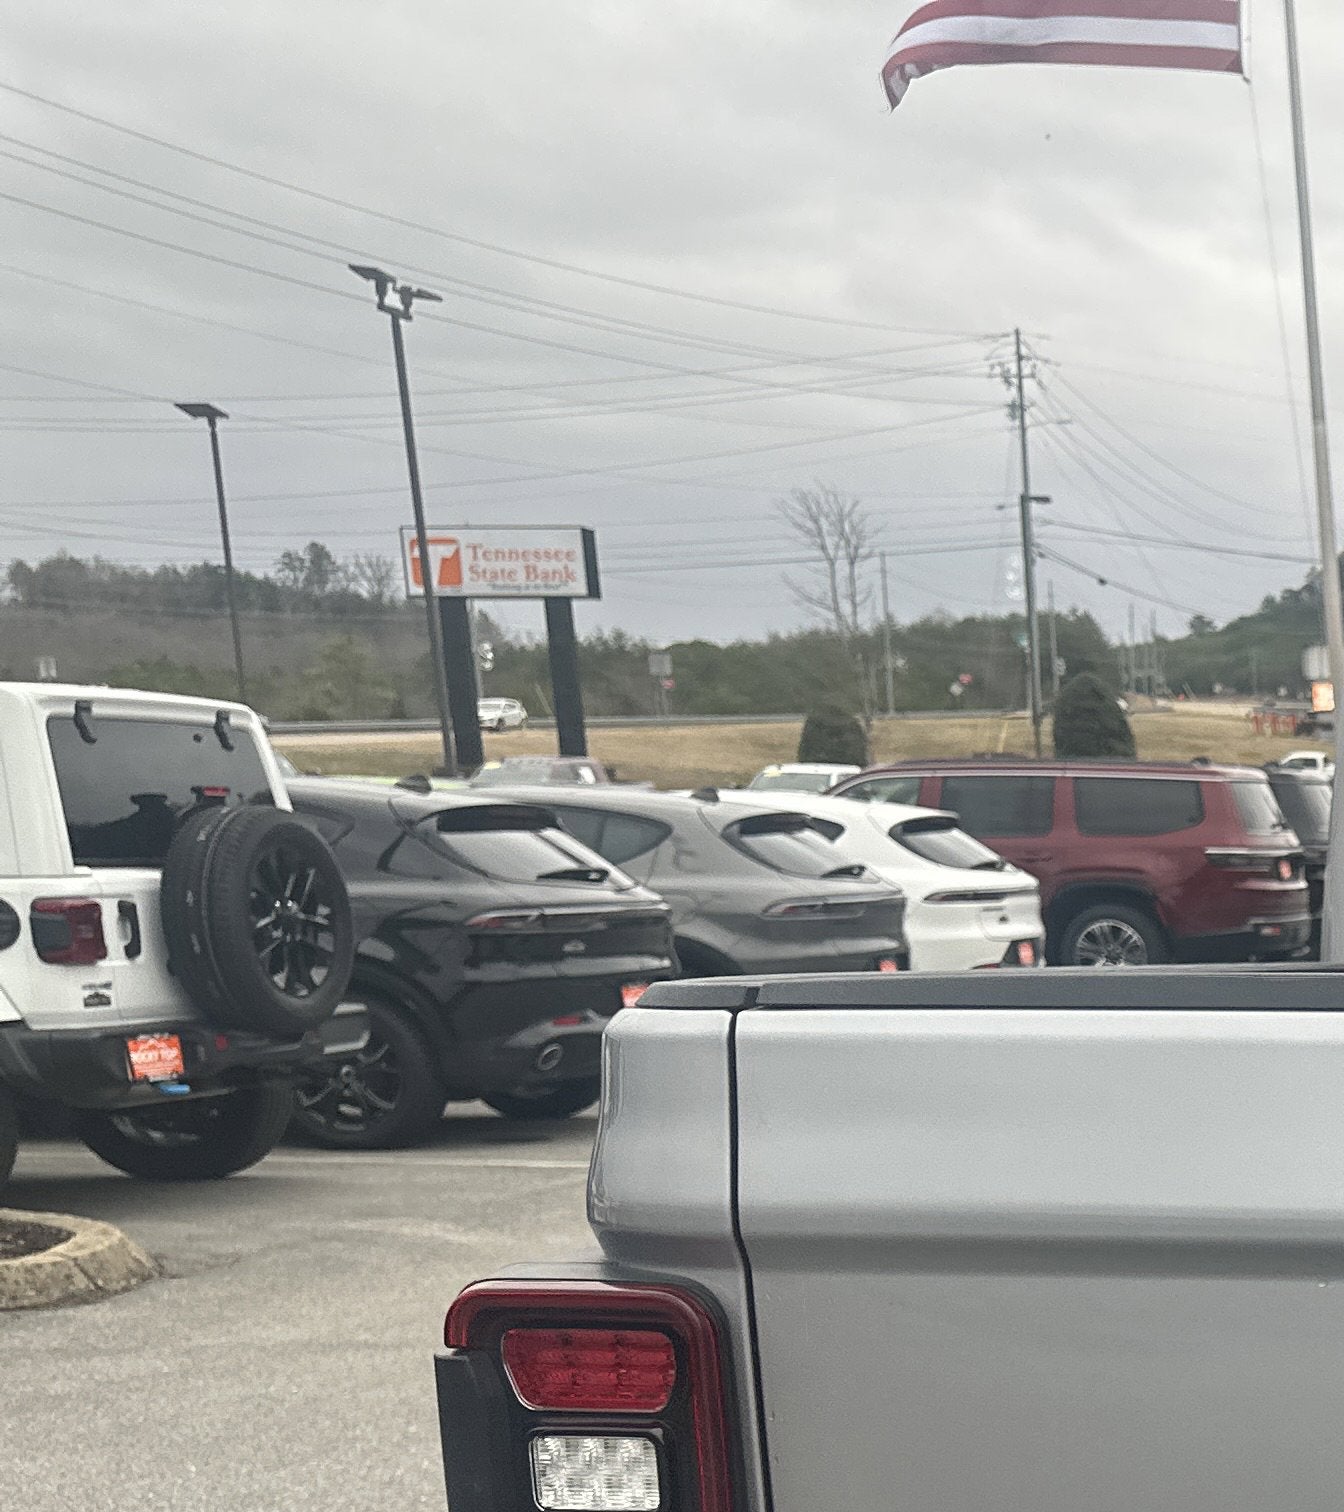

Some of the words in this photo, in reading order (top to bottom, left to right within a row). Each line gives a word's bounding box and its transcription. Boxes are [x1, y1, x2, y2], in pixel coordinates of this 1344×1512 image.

[466, 543, 577, 562] Tennessee
[469, 564, 516, 582] State
[524, 564, 577, 582] Bank
